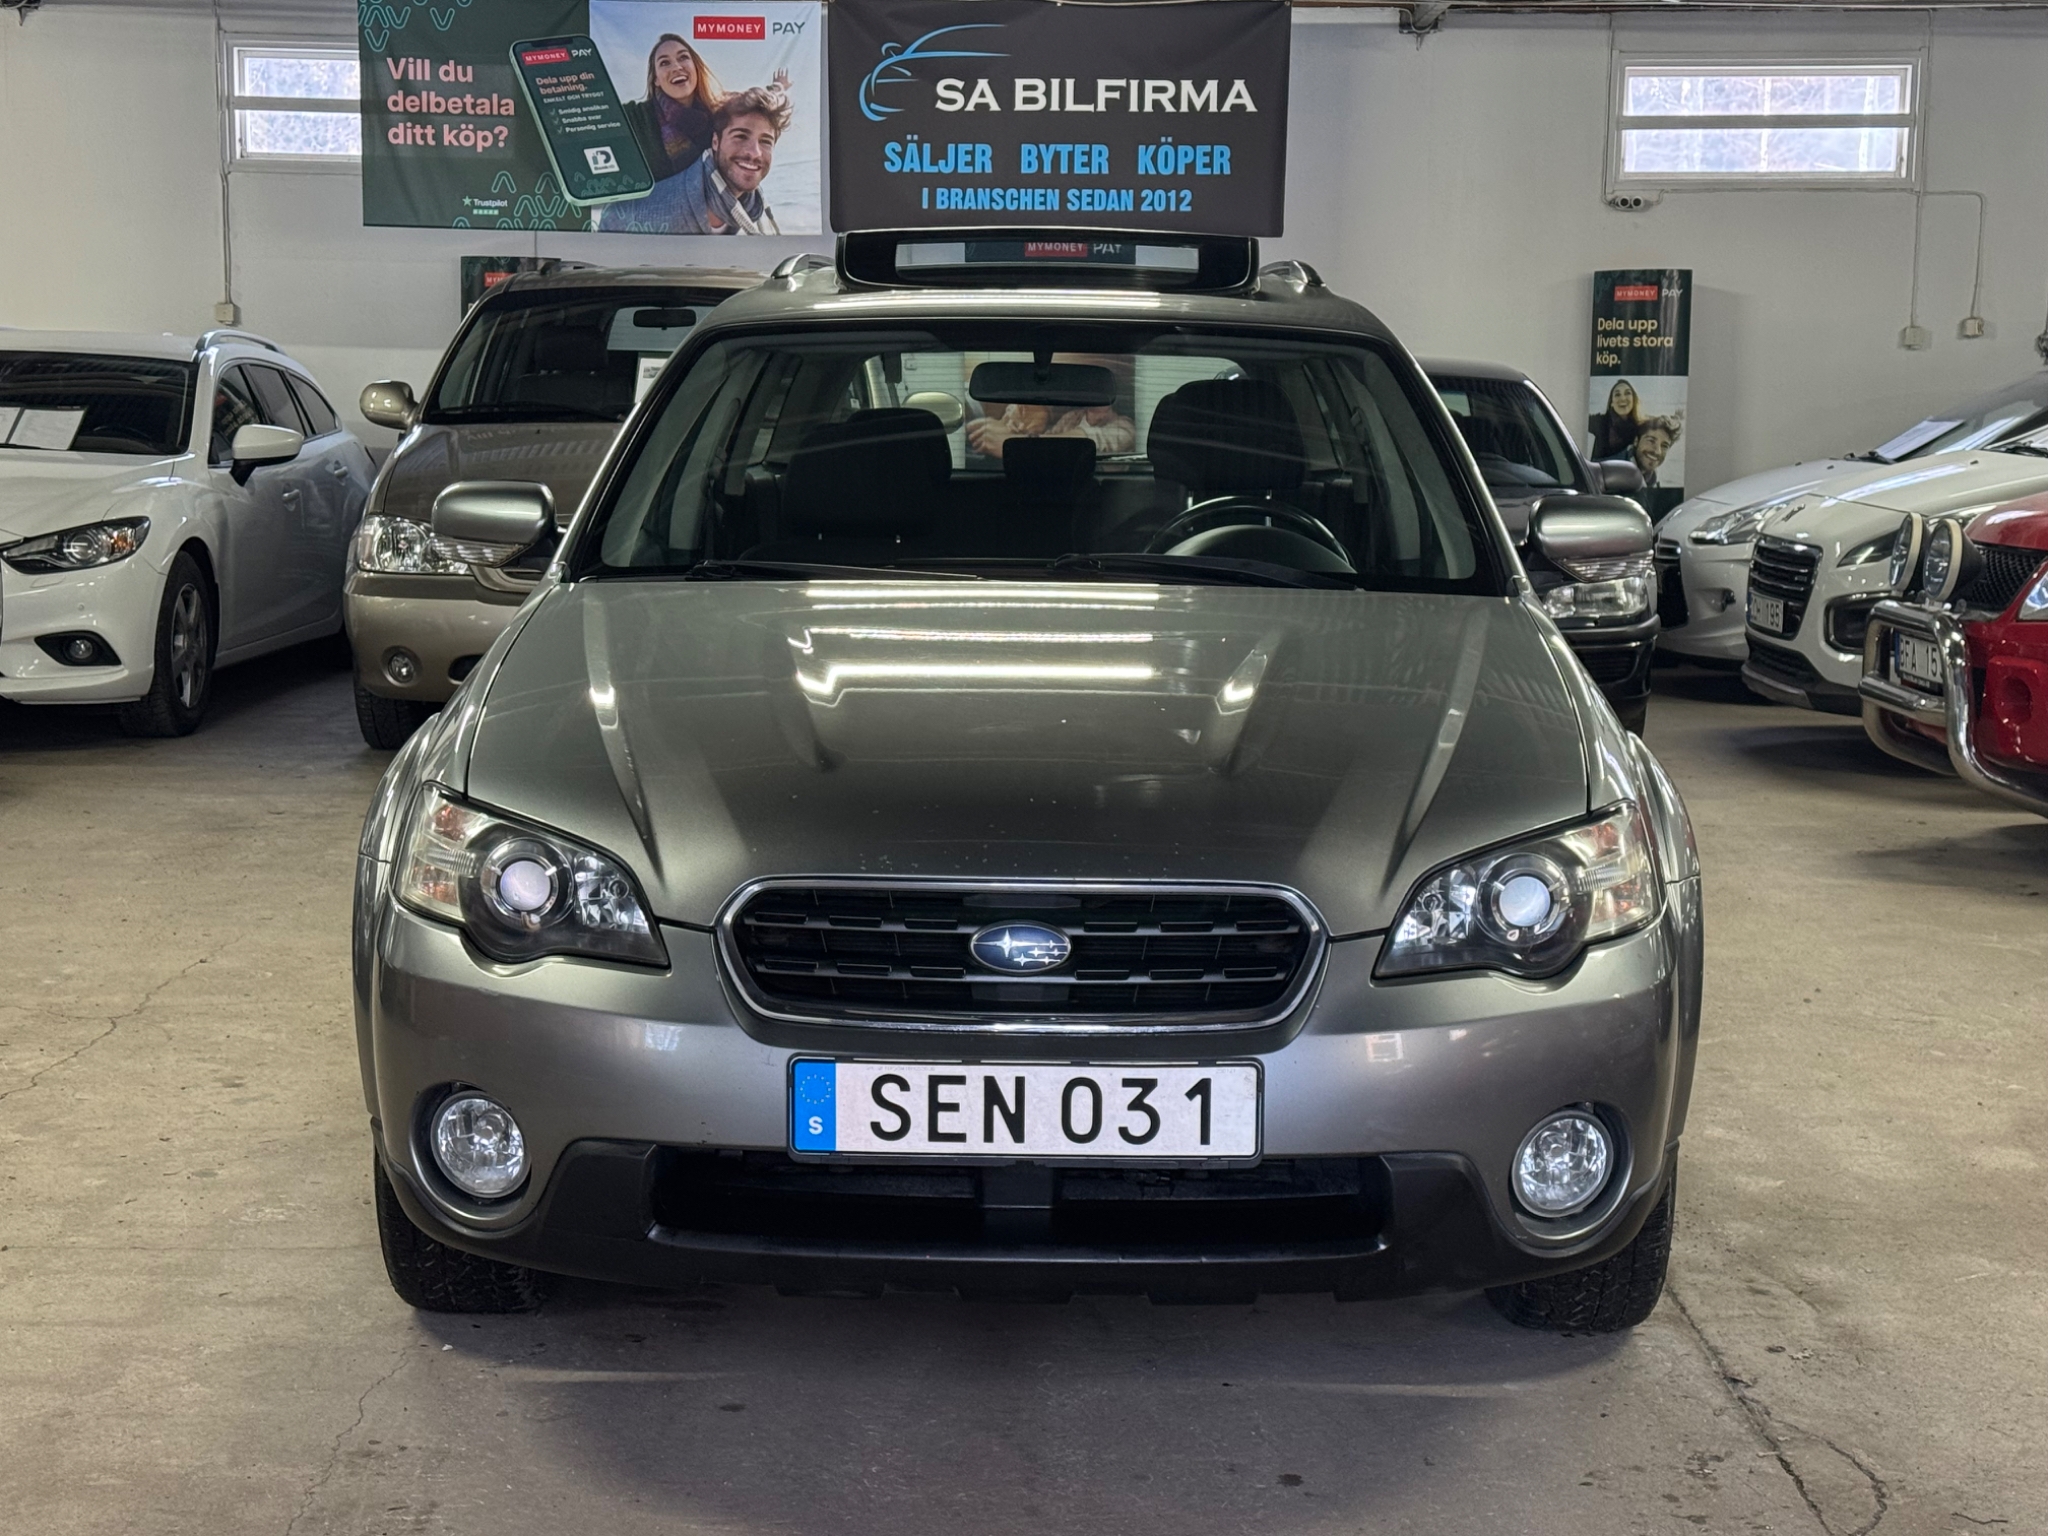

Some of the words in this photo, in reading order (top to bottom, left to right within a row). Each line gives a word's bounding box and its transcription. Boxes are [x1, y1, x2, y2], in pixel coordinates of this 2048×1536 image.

[697, 23, 761, 33] MYMONEY
[772, 21, 805, 35] PAY
[525, 52, 566, 61] MYMONEY
[571, 48, 592, 57] PAY
[386, 57, 431, 81] Vill
[438, 60, 473, 82] du
[535, 76, 558, 85] Dela
[558, 74, 578, 84] upp
[579, 71, 595, 80] din
[386, 90, 515, 116] delbetala
[935, 78, 1001, 112] SA
[1013, 78, 1258, 113] BILFIRMA
[387, 122, 436, 146] ditt
[443, 123, 509, 153] köp?
[884, 134, 993, 174] SÄLJER
[1020, 143, 1109, 175] BYTER
[1137, 136, 1231, 176] KÖPER
[473, 198, 508, 208] Trustpilot
[922, 187, 929, 210] I
[936, 188, 1060, 211] BRANSCHEN
[1067, 189, 1134, 212] SEDAN
[1140, 189, 1193, 213] 2012
[1027, 242, 1084, 253] MYMONEY
[1662, 288, 1683, 298] PAY
[1597, 317, 1625, 331] Dela
[1628, 319, 1658, 333] upp
[1597, 334, 1630, 348] livets
[1633, 335, 1674, 348] stora
[1596, 351, 1621, 367] köp.
[870, 1074, 1026, 1144] SEN
[1061, 1076, 1212, 1147] 031
[808, 1116, 823, 1135] S
